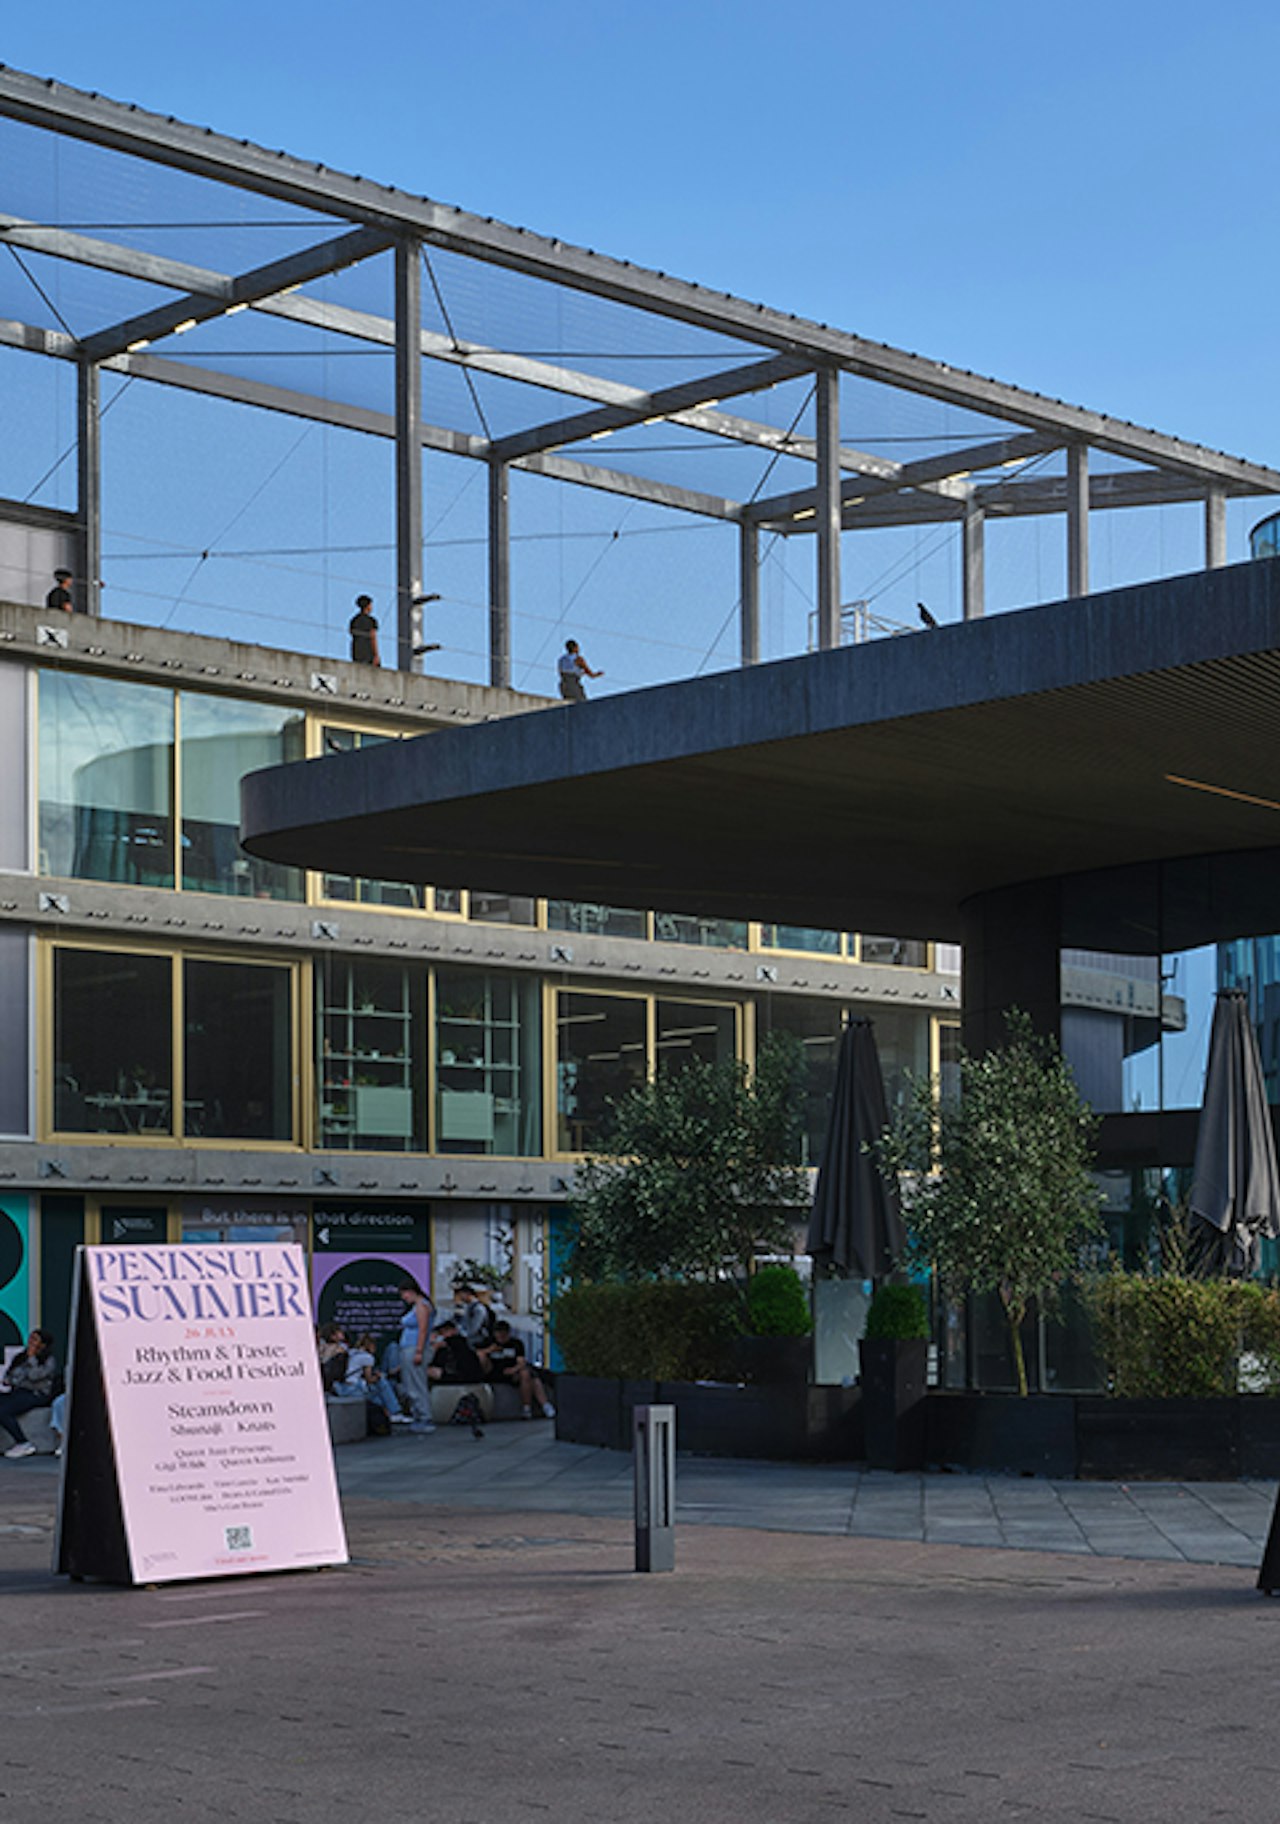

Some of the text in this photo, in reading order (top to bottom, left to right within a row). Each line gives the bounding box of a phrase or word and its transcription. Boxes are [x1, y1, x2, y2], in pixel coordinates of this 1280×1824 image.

[203, 1208, 415, 1225] But there is in that direction
[93, 1251, 300, 1281] PENINSULA
[98, 1282, 305, 1323] SUMMER
[135, 1344, 287, 1367] Rhythm & Taste:
[122, 1361, 305, 1385] Jazz & Food Festival
[168, 1400, 273, 1419] Steamdown
